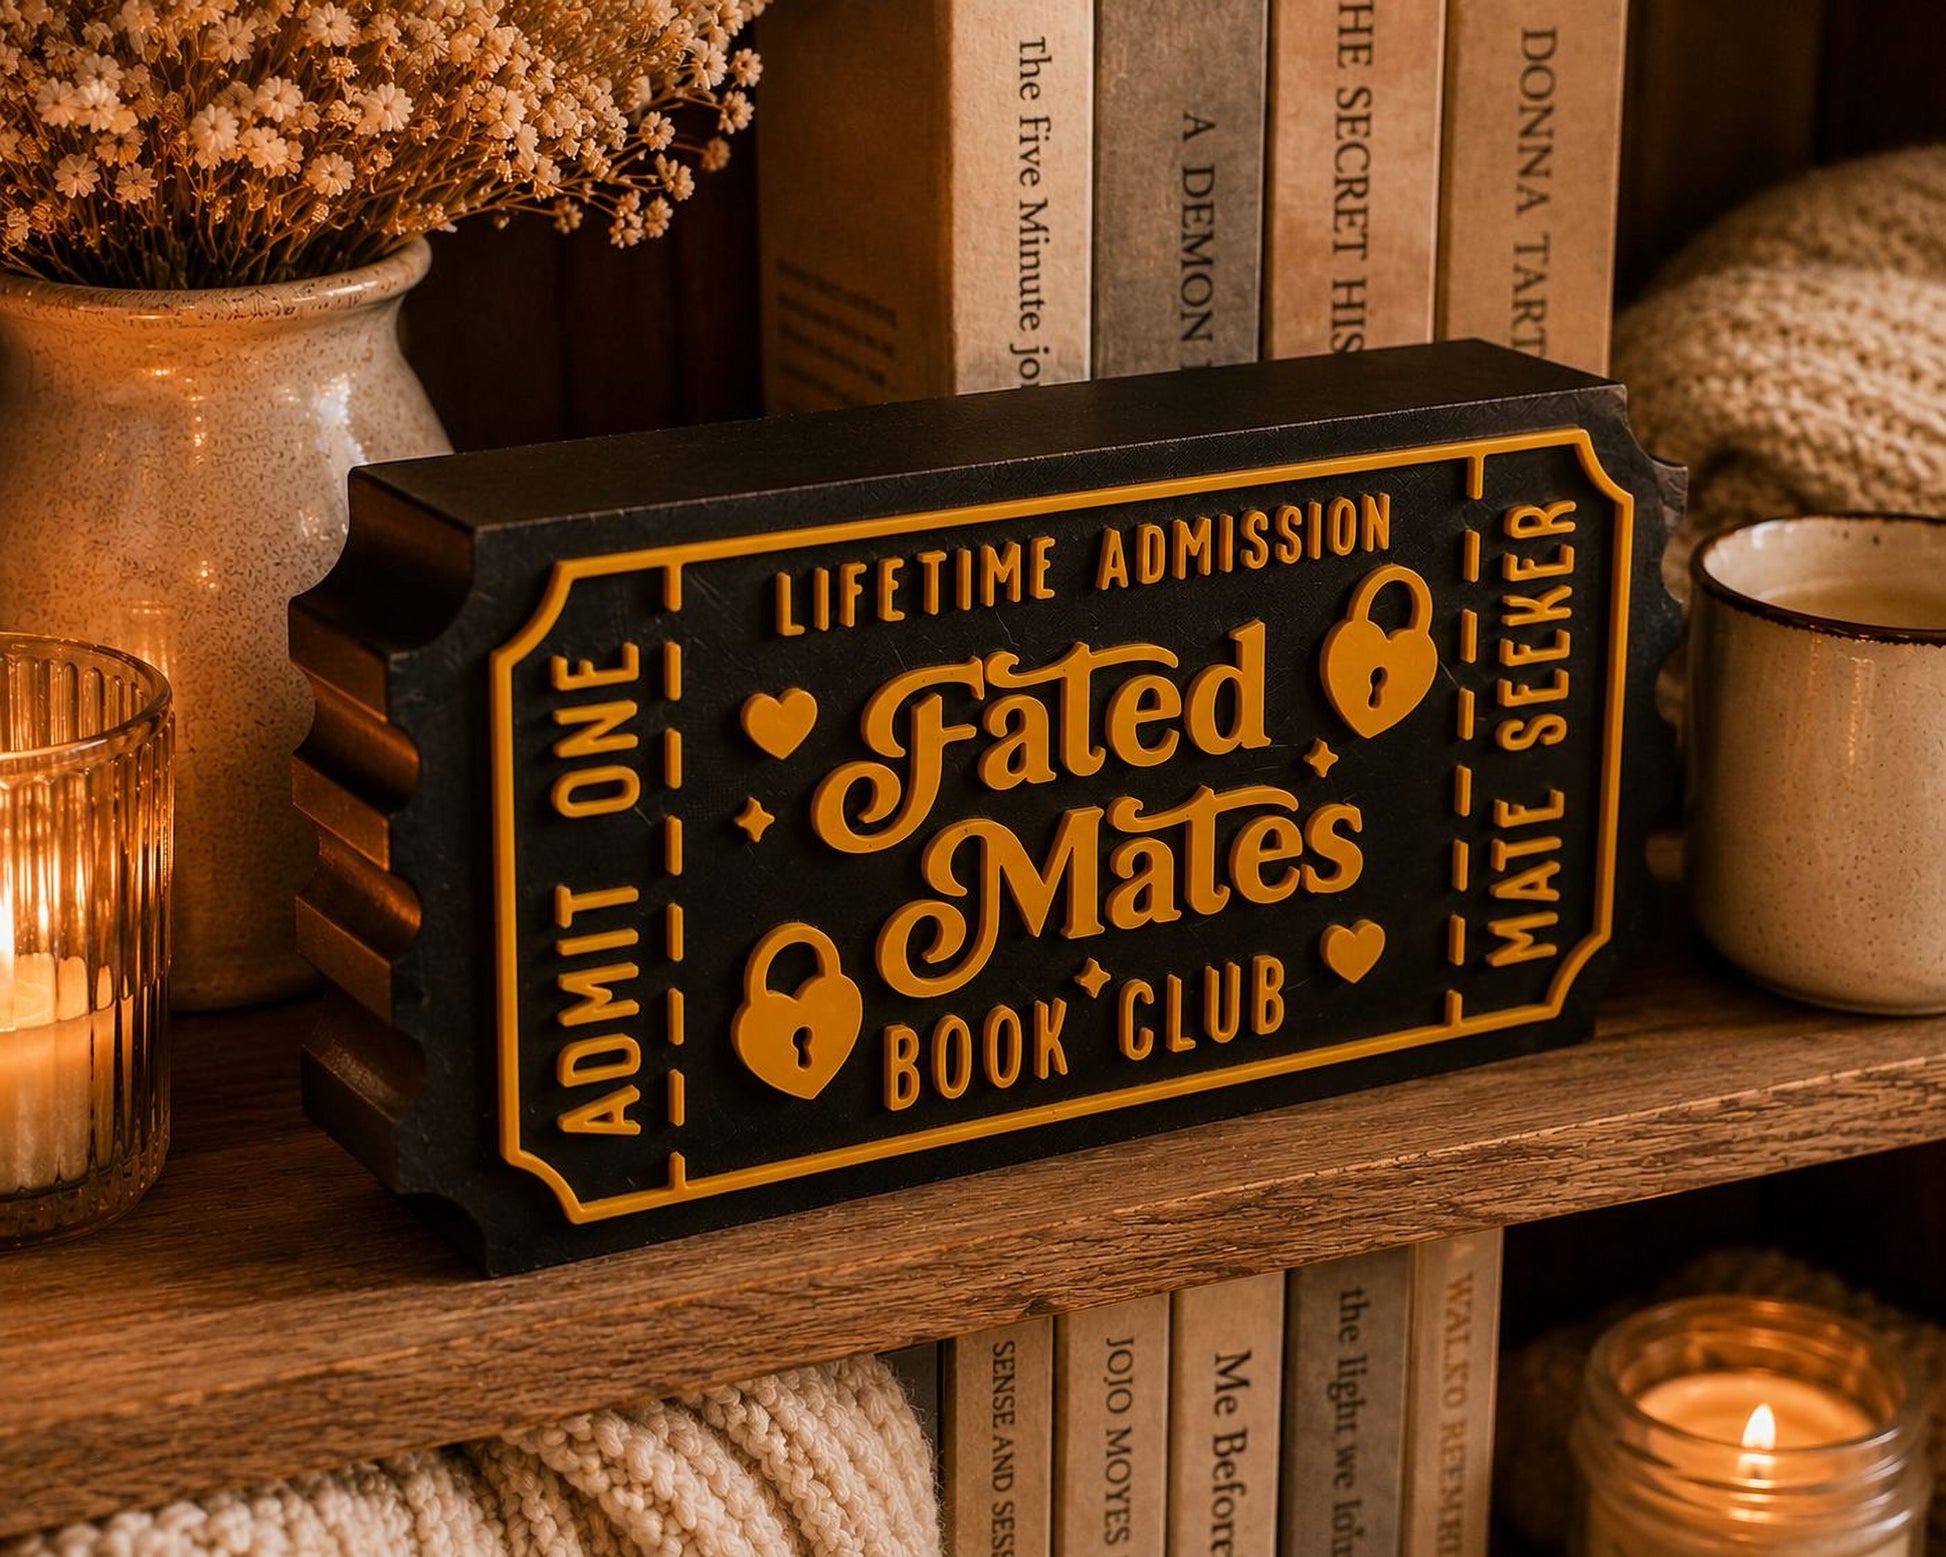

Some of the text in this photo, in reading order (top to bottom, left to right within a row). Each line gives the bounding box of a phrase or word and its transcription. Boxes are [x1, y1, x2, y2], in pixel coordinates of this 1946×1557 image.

[1019, 36, 1053, 101] The
[1182, 112, 1217, 142] A
[1515, 27, 1558, 215] DONNA
[1332, 87, 1374, 262] SECRET
[1018, 197, 1051, 332] Minute
[1180, 163, 1216, 342] DEMON
[1009, 342, 1050, 388] jo
[776, 492, 1392, 638] LIFETIME ADMISSION
[812, 618, 1273, 855] Fated
[1485, 500, 1577, 967] MATE SEEKER
[550, 640, 642, 1137] ADMIT ONE
[877, 784, 1366, 999] Mates
[885, 953, 1286, 1113] BOOK CLUB
[1103, 1336, 1135, 1415] JOJO
[1337, 1286, 1371, 1344] the
[991, 1339, 1017, 1428] SENSE
[1213, 1349, 1254, 1417] Me
[991, 1434, 1016, 1493] AND
[1104, 1425, 1134, 1546] MOYES
[1333, 1443, 1358, 1489] we
